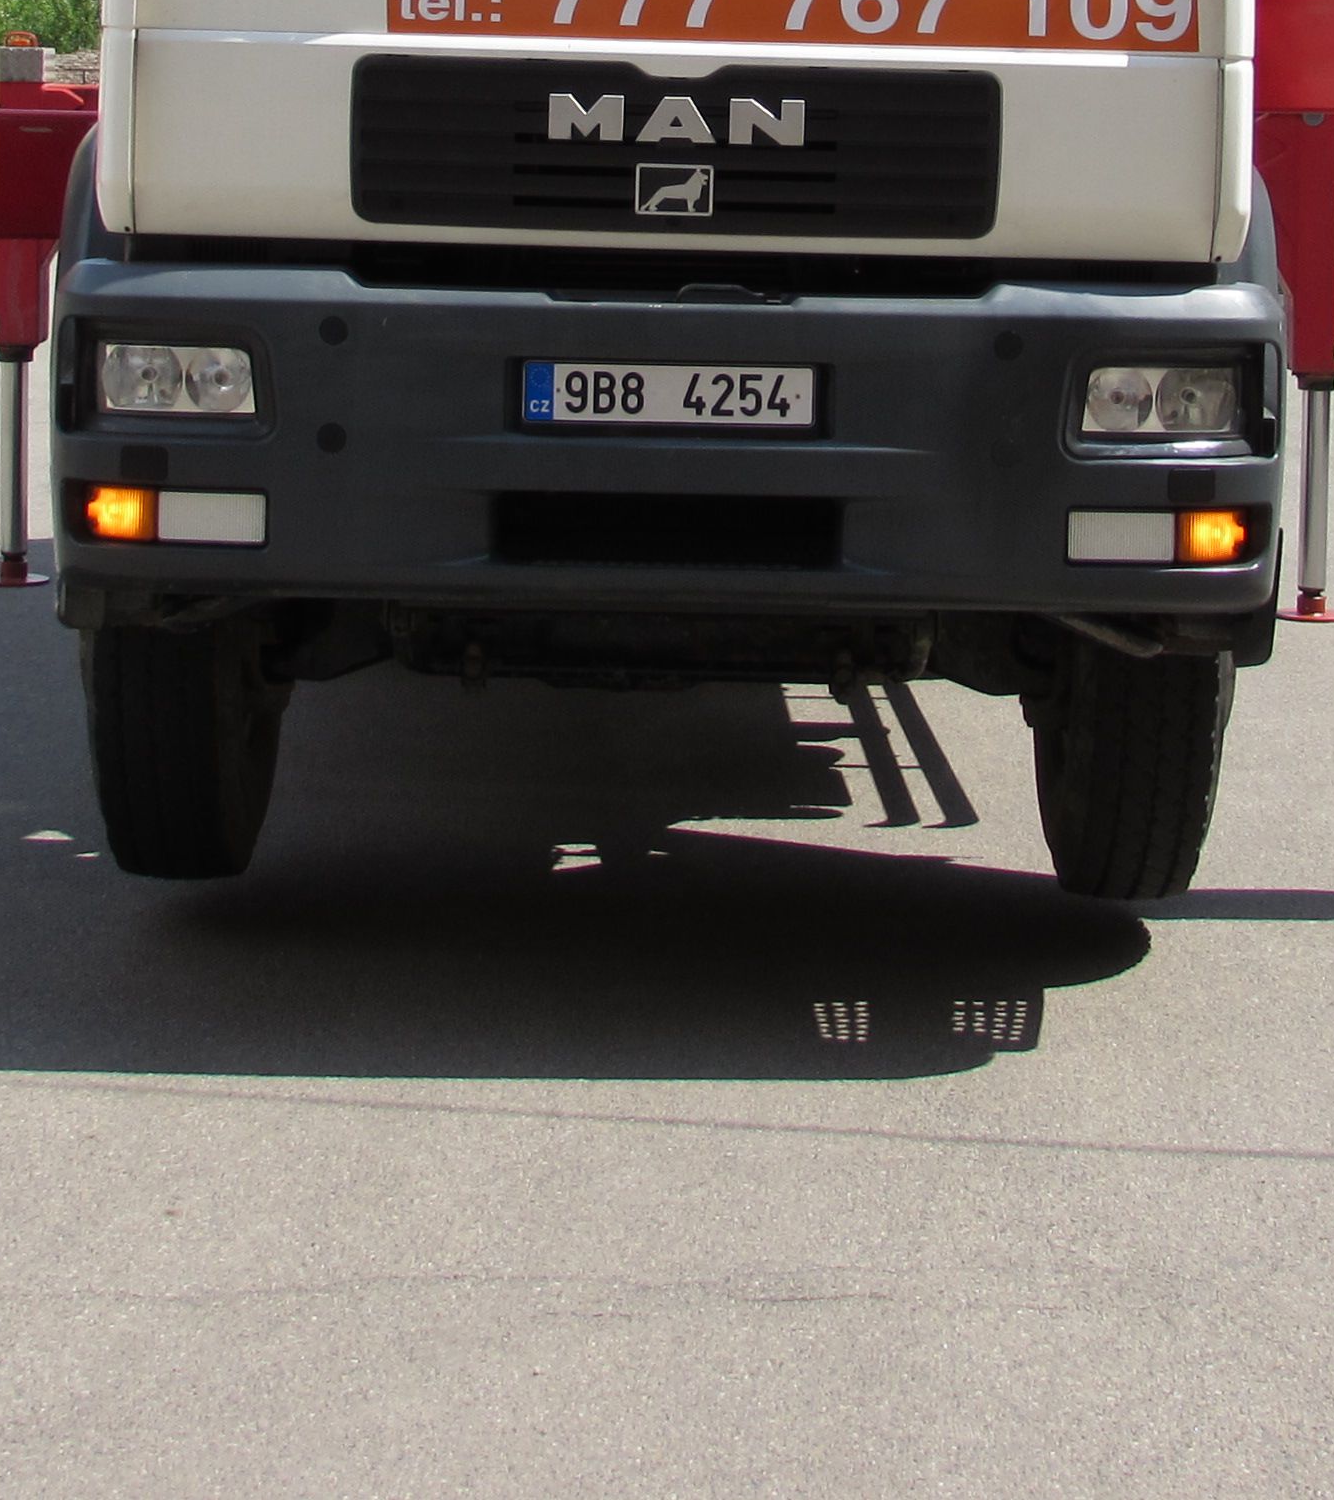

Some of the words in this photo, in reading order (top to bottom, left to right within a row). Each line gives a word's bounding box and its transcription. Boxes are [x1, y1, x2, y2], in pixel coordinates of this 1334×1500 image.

[548, 93, 806, 146] MAN
[530, 399, 550, 413] CZ
[565, 371, 645, 414] 9B8
[683, 373, 790, 417] 4254
